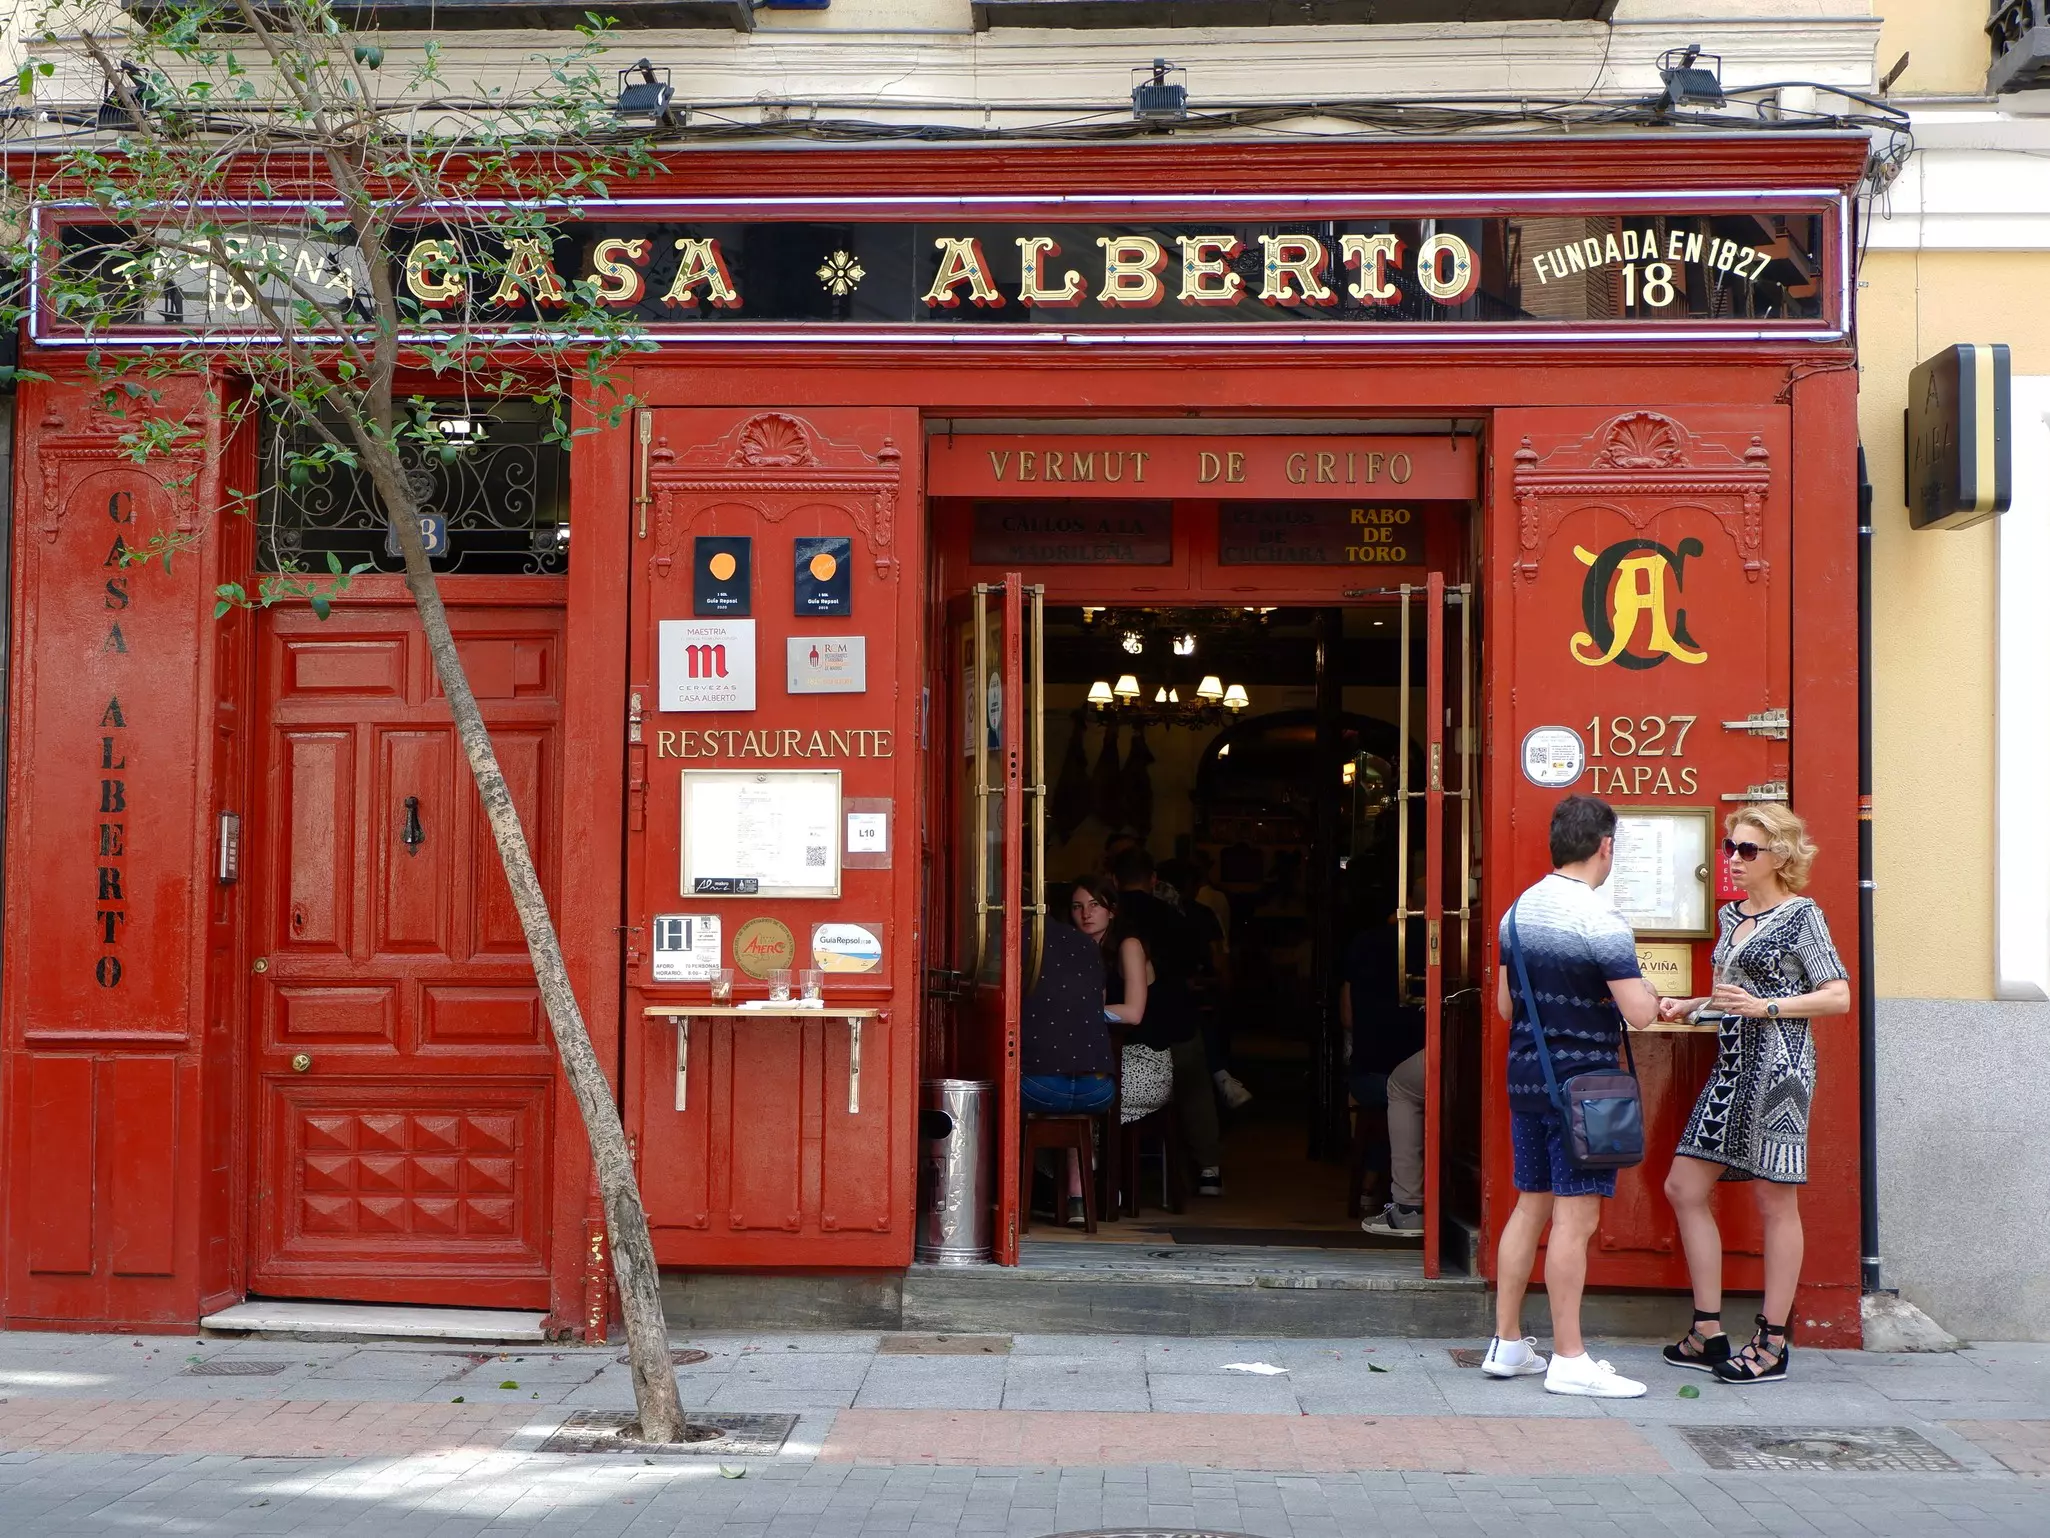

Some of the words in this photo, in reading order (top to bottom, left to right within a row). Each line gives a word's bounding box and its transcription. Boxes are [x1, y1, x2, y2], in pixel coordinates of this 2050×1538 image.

[406, 238, 742, 307] CASA
[921, 234, 1480, 308] ALBERTO
[1533, 229, 1658, 284] FUNDADA
[1669, 231, 1703, 264] EN
[1708, 238, 1772, 281] 1827
[1622, 262, 1675, 307] 18
[987, 450, 1150, 483] VERMUT
[1198, 450, 1247, 484] DE
[1285, 450, 1414, 484] GRIFO
[1350, 508, 1411, 525] RABO
[1363, 527, 1393, 543] DE
[1345, 545, 1406, 562] TORO
[104, 491, 132, 654] CASA
[679, 693, 700, 702] CASA
[701, 692, 737, 702] ALBERTO
[657, 729, 894, 759] RESTAURANTE
[1586, 715, 1697, 757] 1827
[1584, 765, 1698, 796] TAPAS
[96, 695, 128, 988] ALBERTO
[859, 829, 875, 837] L10
[1650, 960, 1679, 971] VIÑA
